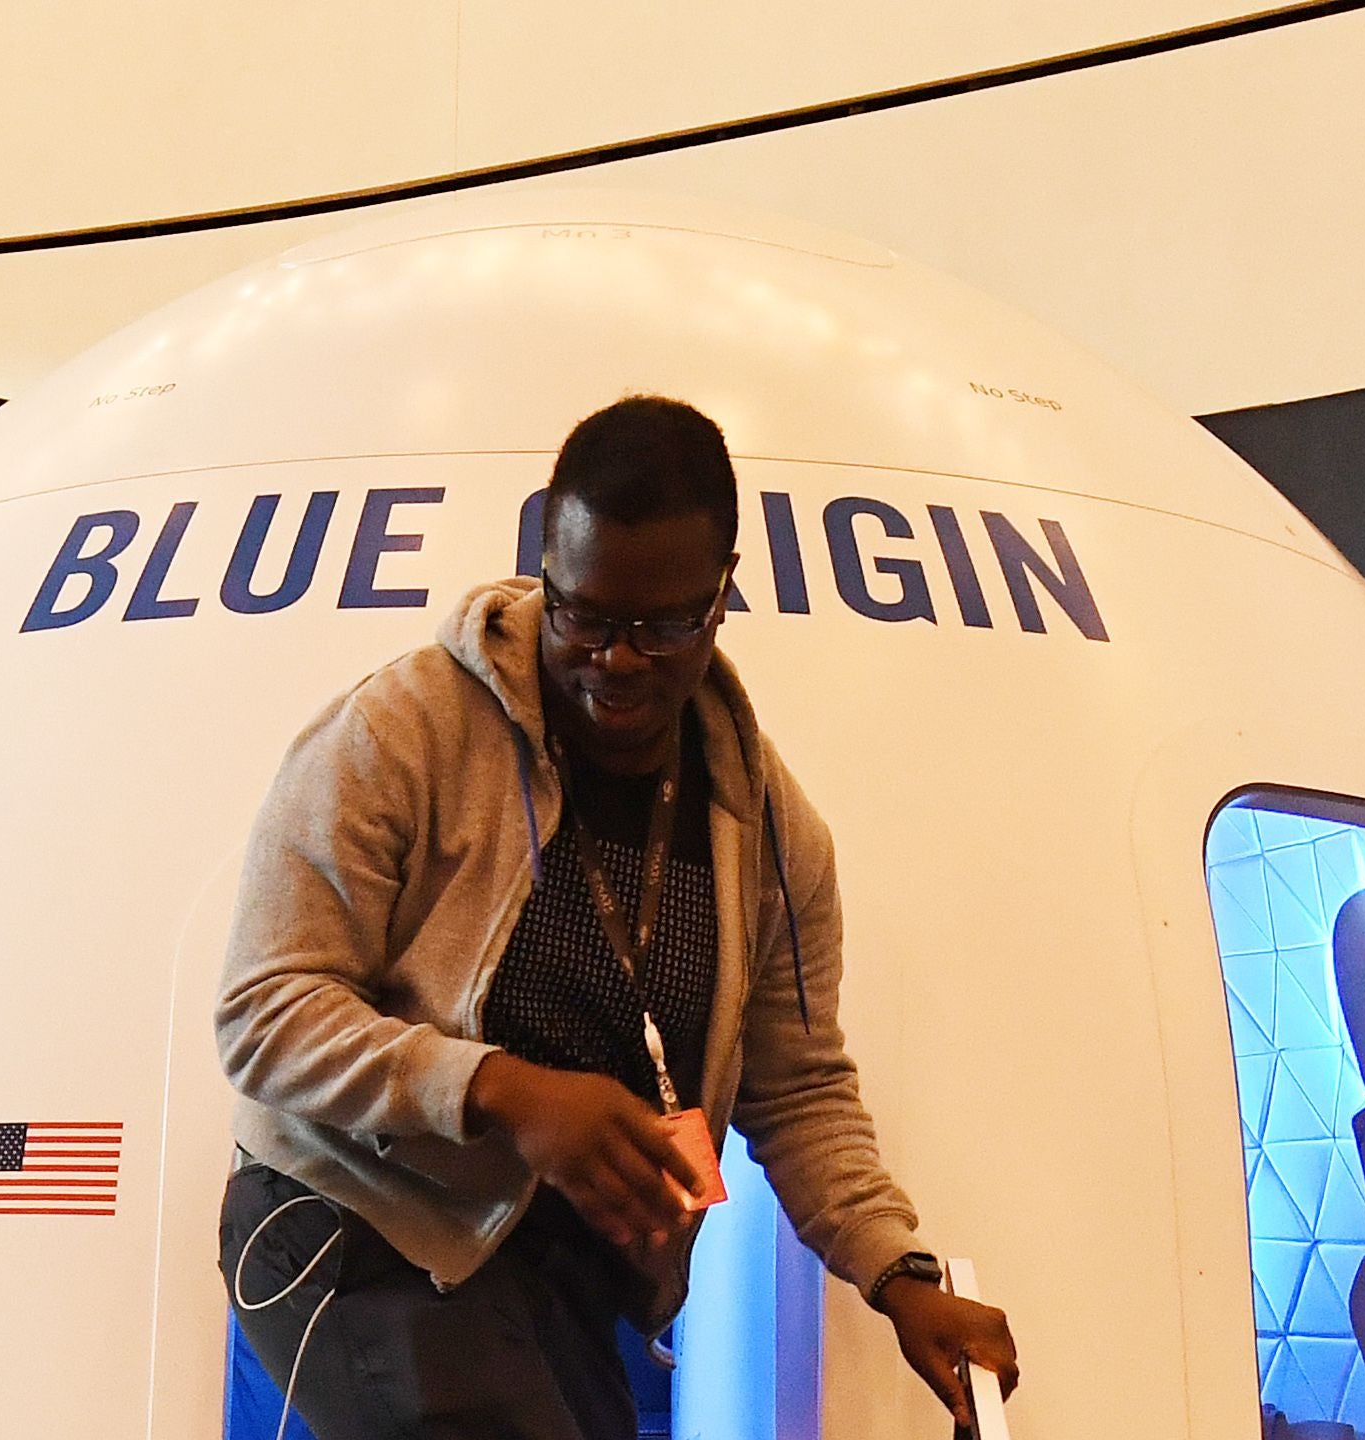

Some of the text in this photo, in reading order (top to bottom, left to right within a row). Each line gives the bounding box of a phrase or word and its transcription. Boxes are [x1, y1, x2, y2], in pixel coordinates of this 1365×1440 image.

[123, 382, 177, 401] Step
[969, 382, 1062, 411] No Step
[19, 487, 1111, 643] BLUE IGIN
